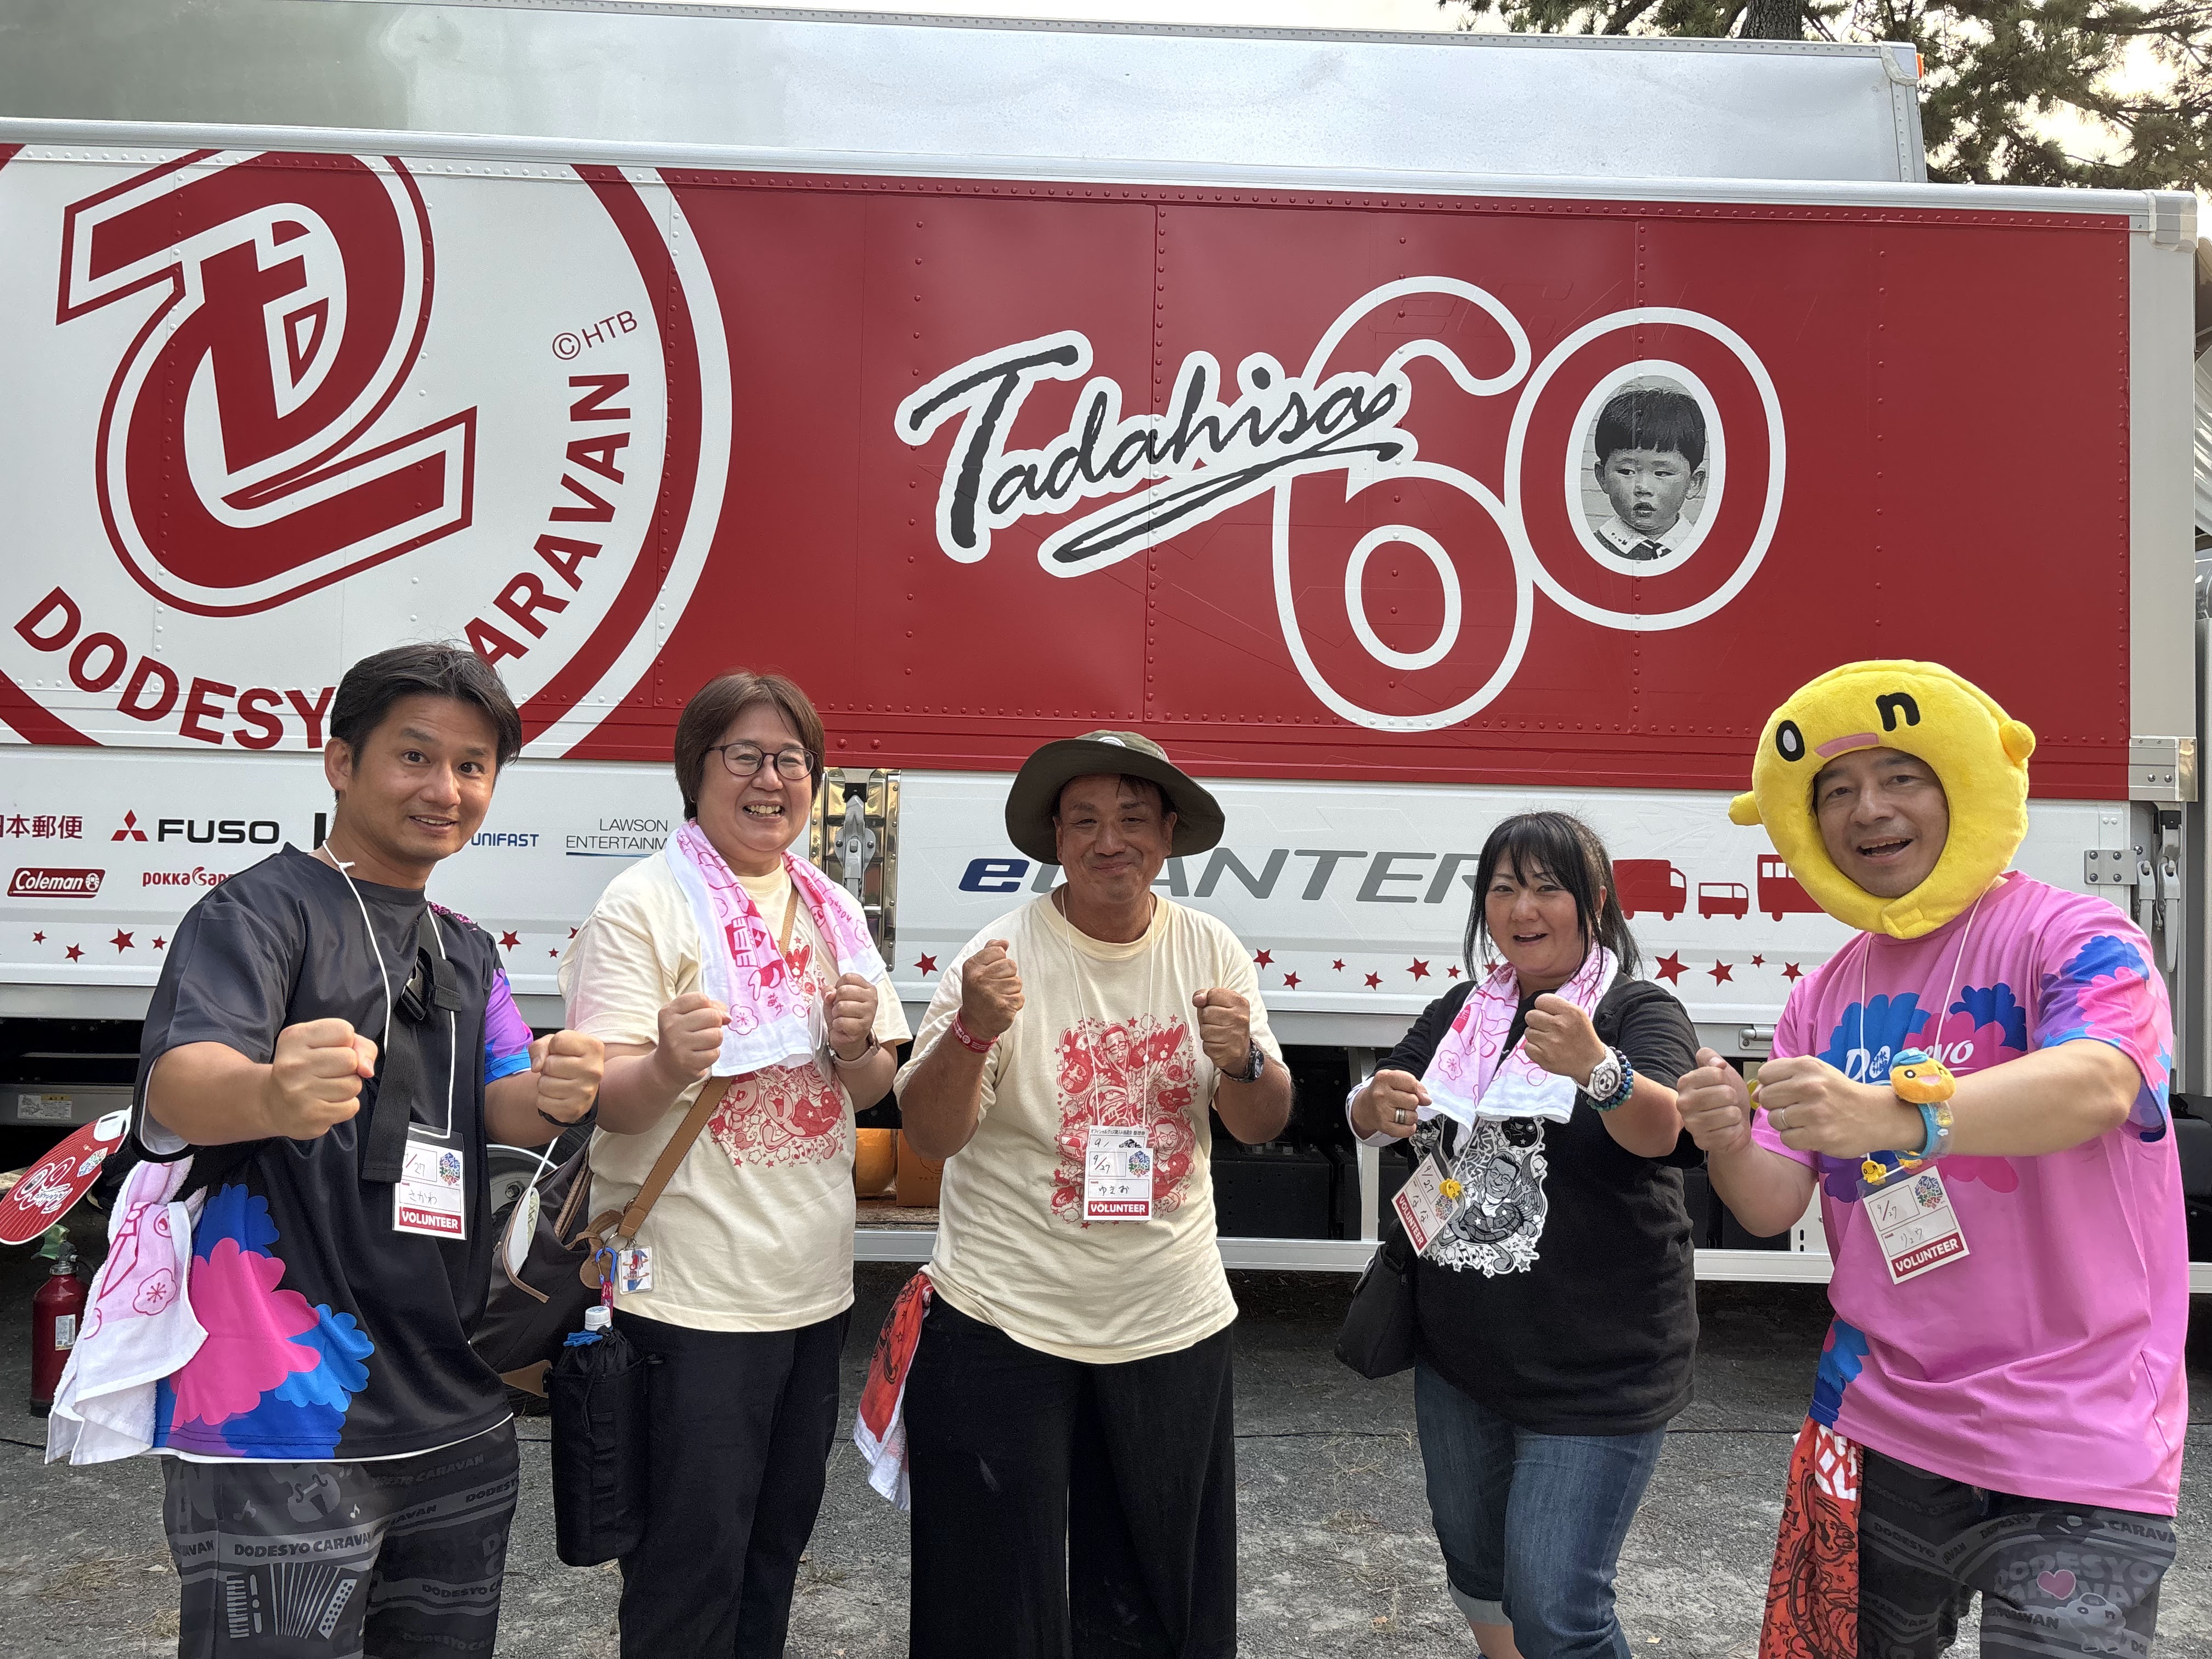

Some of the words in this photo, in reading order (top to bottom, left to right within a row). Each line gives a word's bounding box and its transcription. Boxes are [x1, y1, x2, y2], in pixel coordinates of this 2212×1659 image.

[900, 335, 1404, 554] Tadahisa
[157, 819, 280, 844] FUSO
[600, 819, 668, 832] LAWSON
[471, 833, 539, 848] UNIFAST
[14, 870, 82, 892] Coleman
[1091, 1204, 1146, 1214] VOLUNTEER
[402, 1211, 459, 1229] VOLUNTEER
[1399, 1197, 1425, 1246] VOLUNTEER
[1895, 1238, 1959, 1272] VOLUNTEER
[234, 1543, 311, 1558] DODESYO
